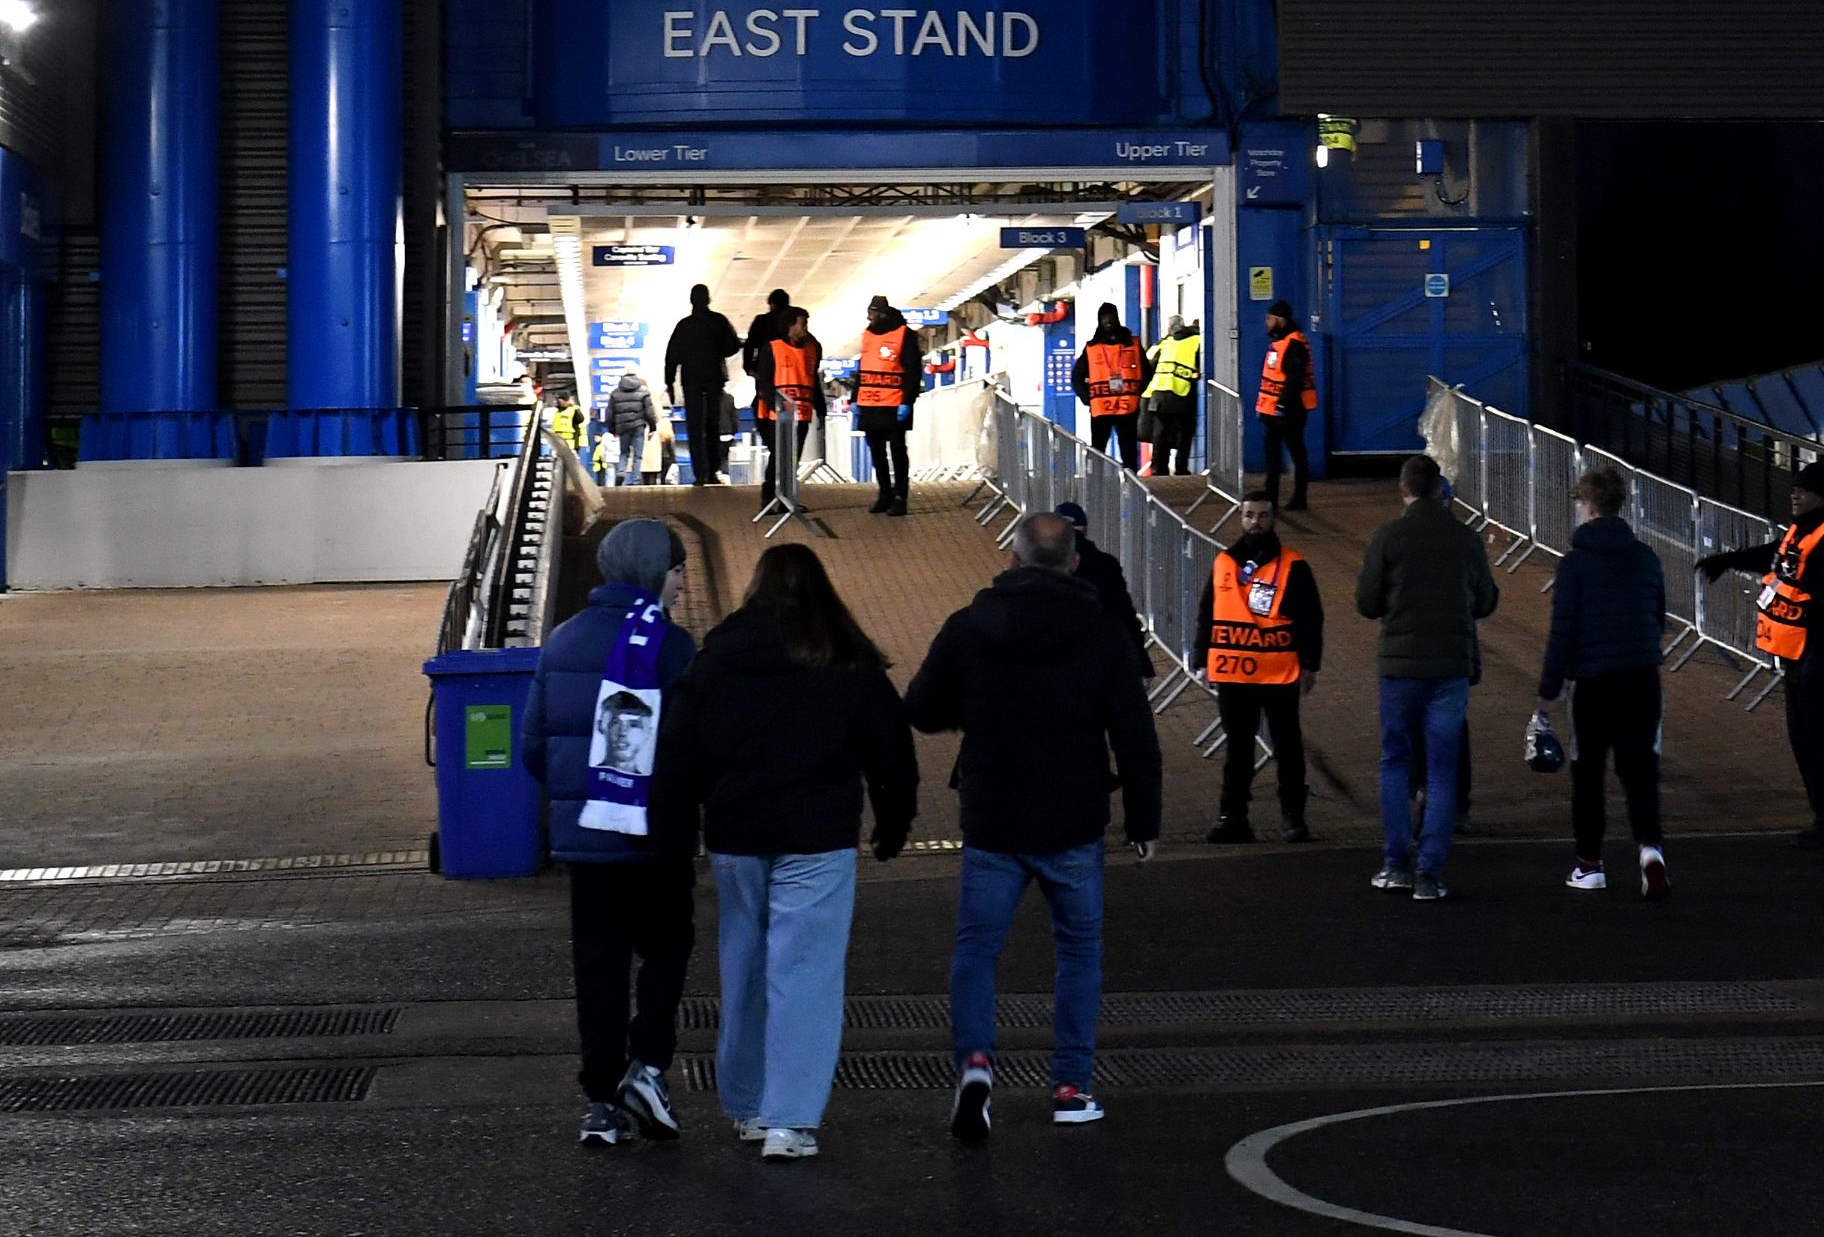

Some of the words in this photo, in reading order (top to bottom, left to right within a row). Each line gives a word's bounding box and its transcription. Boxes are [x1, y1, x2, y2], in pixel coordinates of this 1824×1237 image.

[661, 10, 818, 58] EAST
[843, 9, 1039, 58] STAND
[613, 146, 669, 162] Lower
[672, 145, 709, 161] Tier
[1115, 142, 1171, 161] Upper
[1174, 141, 1209, 157] Tier
[1173, 206, 1183, 218] 1
[1018, 231, 1054, 244] Block
[1057, 231, 1067, 244] 3
[1216, 654, 1257, 676] 270
